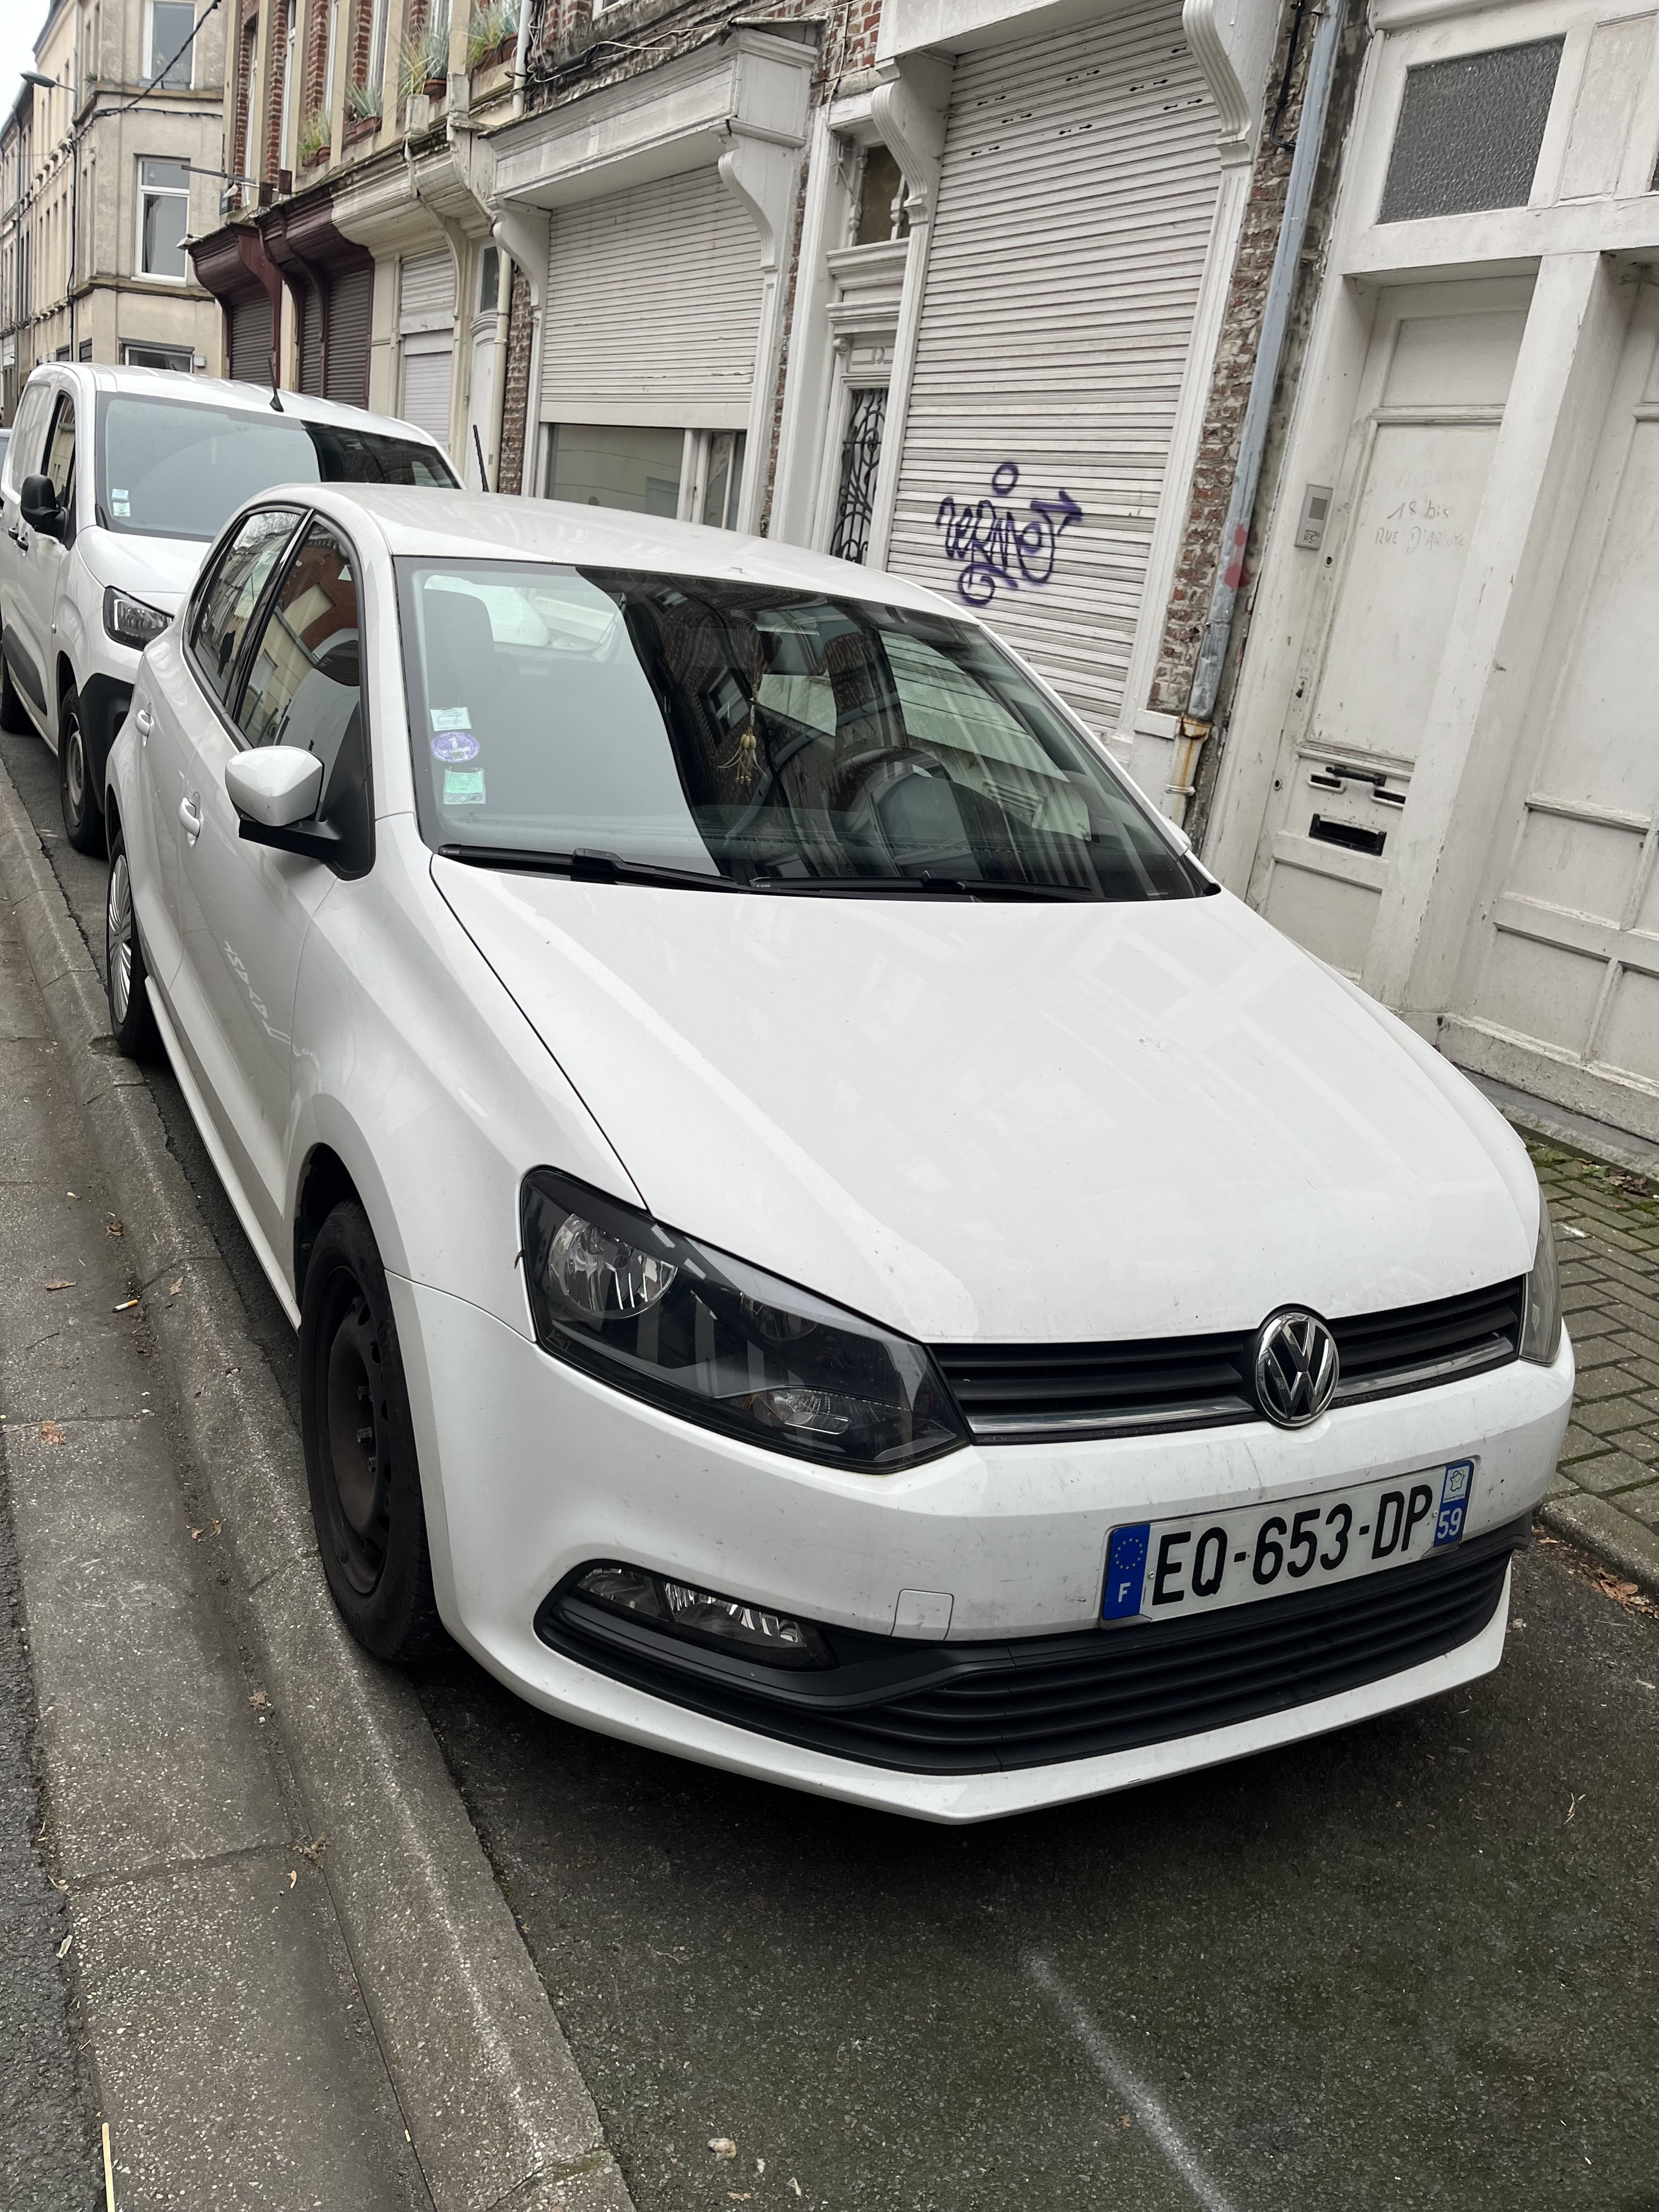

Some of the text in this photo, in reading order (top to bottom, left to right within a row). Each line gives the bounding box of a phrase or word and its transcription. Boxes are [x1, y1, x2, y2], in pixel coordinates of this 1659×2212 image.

[1386, 500, 1449, 520] 18 bis
[1375, 527, 1398, 545] RUE
[1437, 1507, 1463, 1539] 59
[1152, 1485, 1433, 1606] EQ-653-DP
[1118, 1582, 1131, 1602] F
